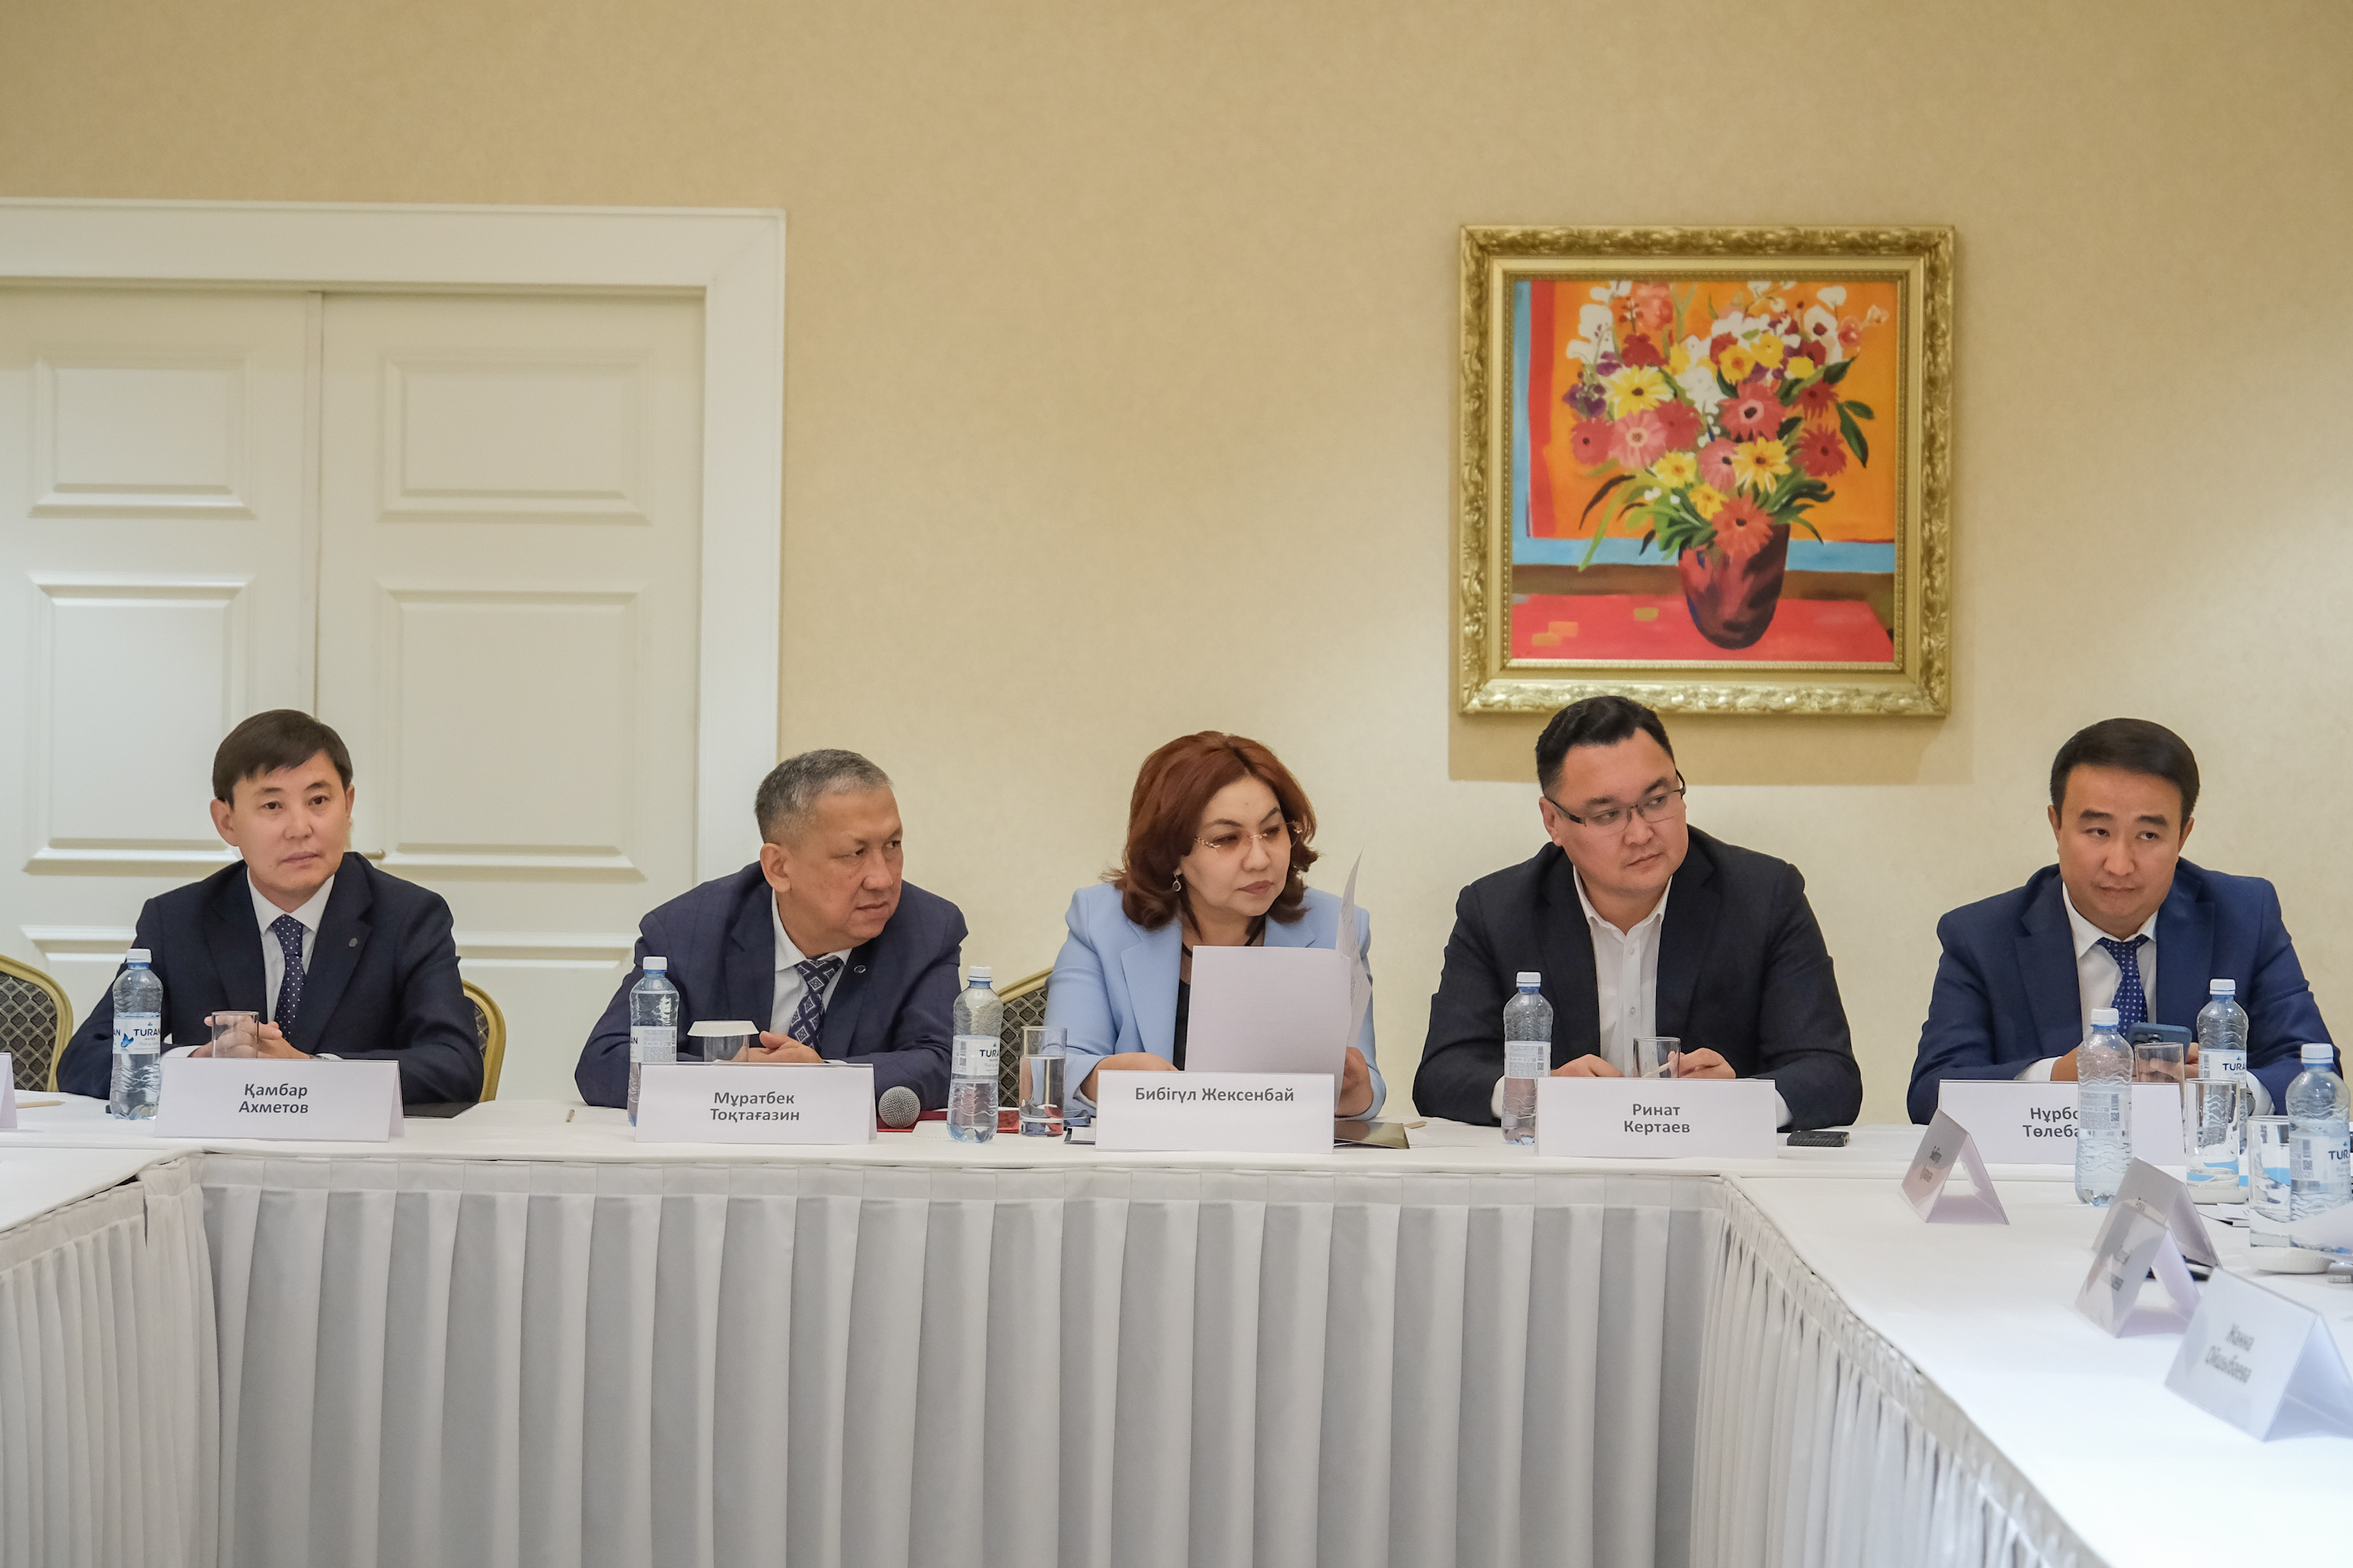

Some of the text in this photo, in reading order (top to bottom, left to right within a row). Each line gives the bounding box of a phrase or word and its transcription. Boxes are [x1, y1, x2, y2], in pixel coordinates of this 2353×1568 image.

[244, 1083, 308, 1099] Қамбар
[1135, 1087, 1294, 1103] Бибігүл Жексенбай
[714, 1091, 795, 1107] Мұратбек
[238, 1101, 309, 1114] Ахметов
[1633, 1103, 1680, 1116] Ринат
[710, 1108, 799, 1123] Тоқтағазин
[1624, 1120, 1691, 1136] Кертаев
[2328, 1149, 2350, 1160] TUR
